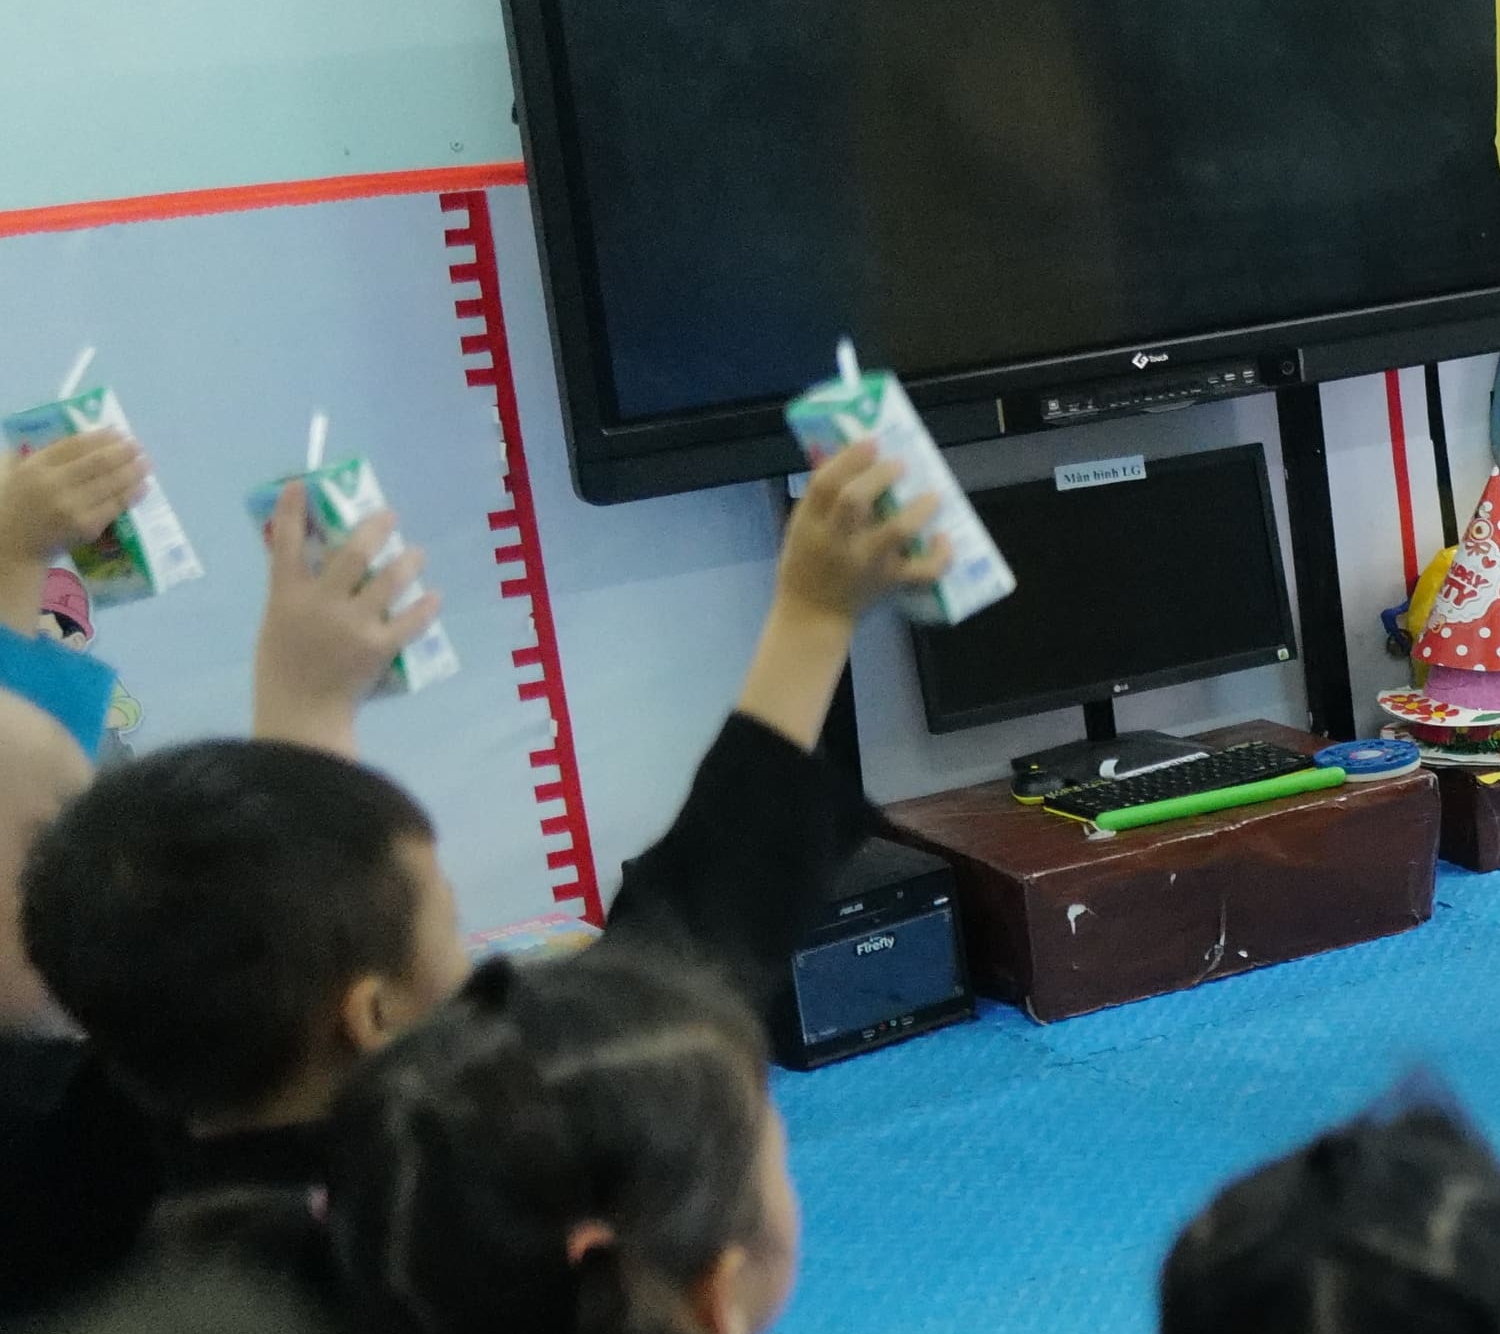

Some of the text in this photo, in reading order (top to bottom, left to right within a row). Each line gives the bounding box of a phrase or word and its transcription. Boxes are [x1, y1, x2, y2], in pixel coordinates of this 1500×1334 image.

[1064, 466, 1141, 484] Màn hình LG
[856, 935, 895, 956] Firefly
